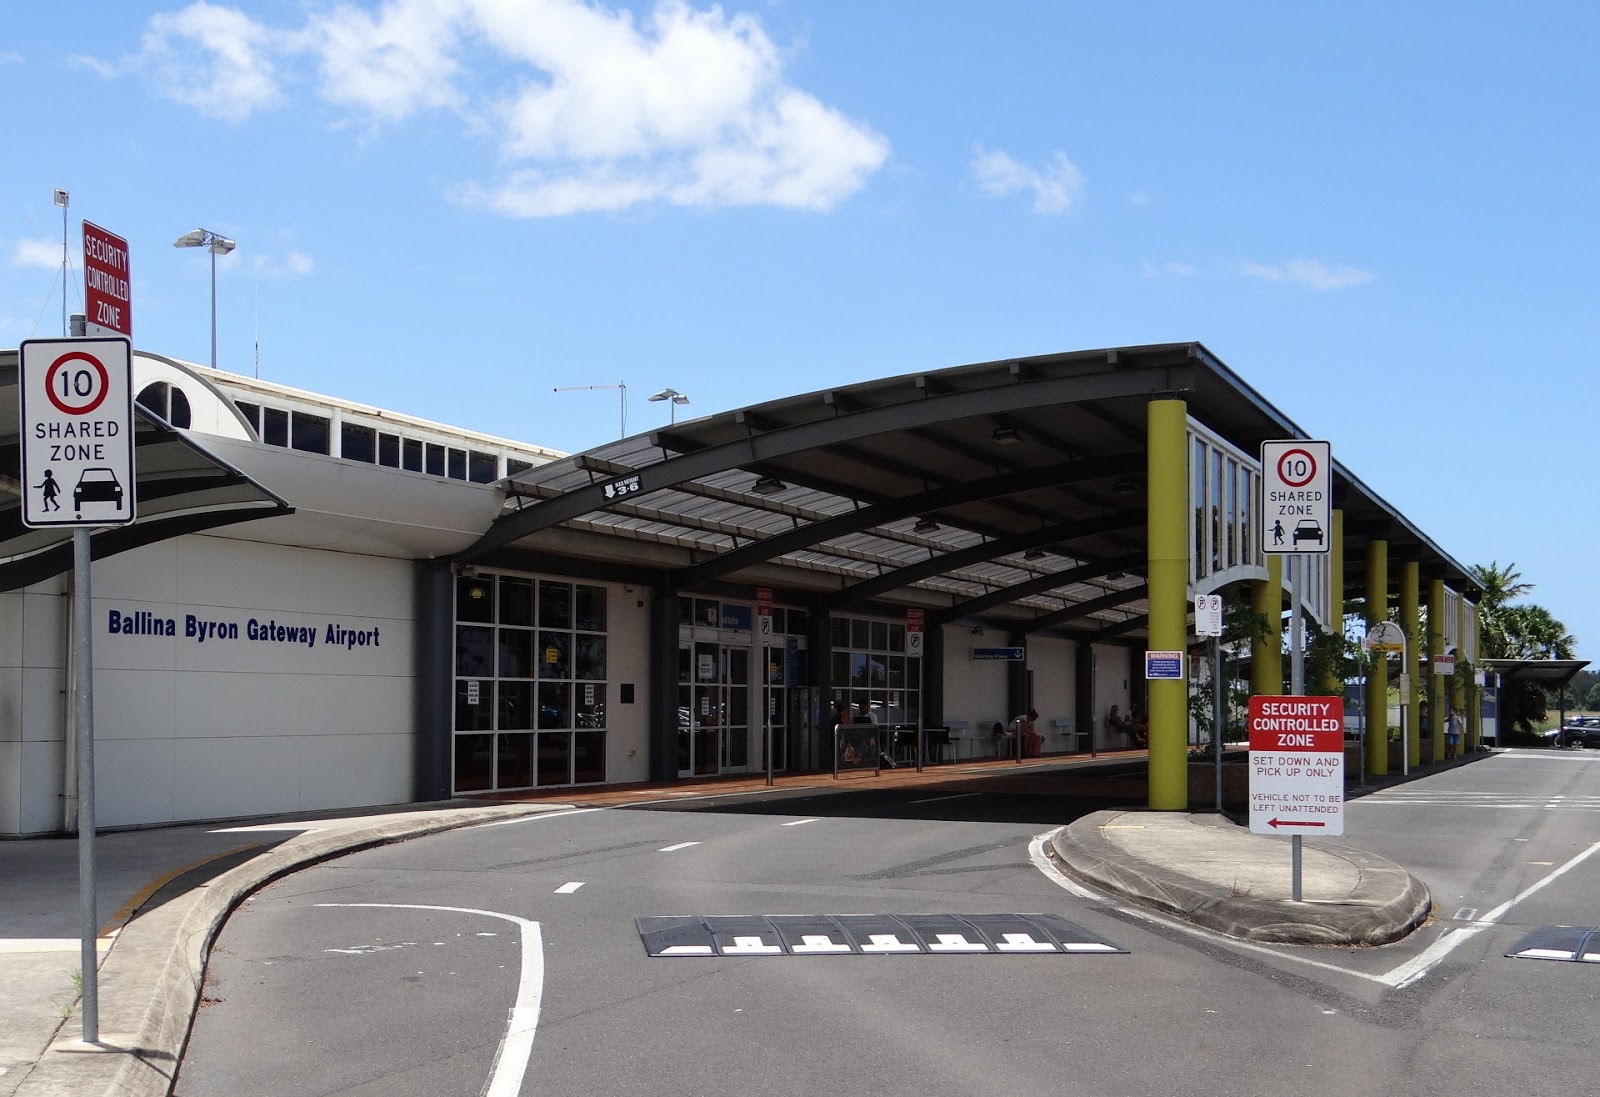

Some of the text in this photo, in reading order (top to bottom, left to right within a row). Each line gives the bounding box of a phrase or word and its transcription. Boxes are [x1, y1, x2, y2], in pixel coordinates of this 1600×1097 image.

[86, 235, 127, 271] SECURITY
[88, 266, 129, 302] CONTROLLED
[97, 301, 121, 328] ZONE
[61, 370, 92, 397] 10
[36, 421, 119, 438] SHARED
[50, 444, 105, 461] ZONE
[1286, 460, 1306, 477] 10
[1270, 491, 1322, 502] SHARED
[1278, 505, 1313, 516] ZONE
[108, 610, 380, 650] Ballina Byron Gateway Airport
[1262, 703, 1330, 716] SECURITY
[1253, 718, 1338, 731] CONTROLLED
[1277, 734, 1314, 747] ZONE
[1253, 756, 1339, 767] SET DOWN AND
[1256, 767, 1334, 778] PICK UP ONLY
[1251, 793, 1290, 802] VEHICLE
[1292, 794, 1309, 802] NOT
[1314, 794, 1325, 802] TO
[1253, 804, 1339, 814] LEFT UNATTENDED
